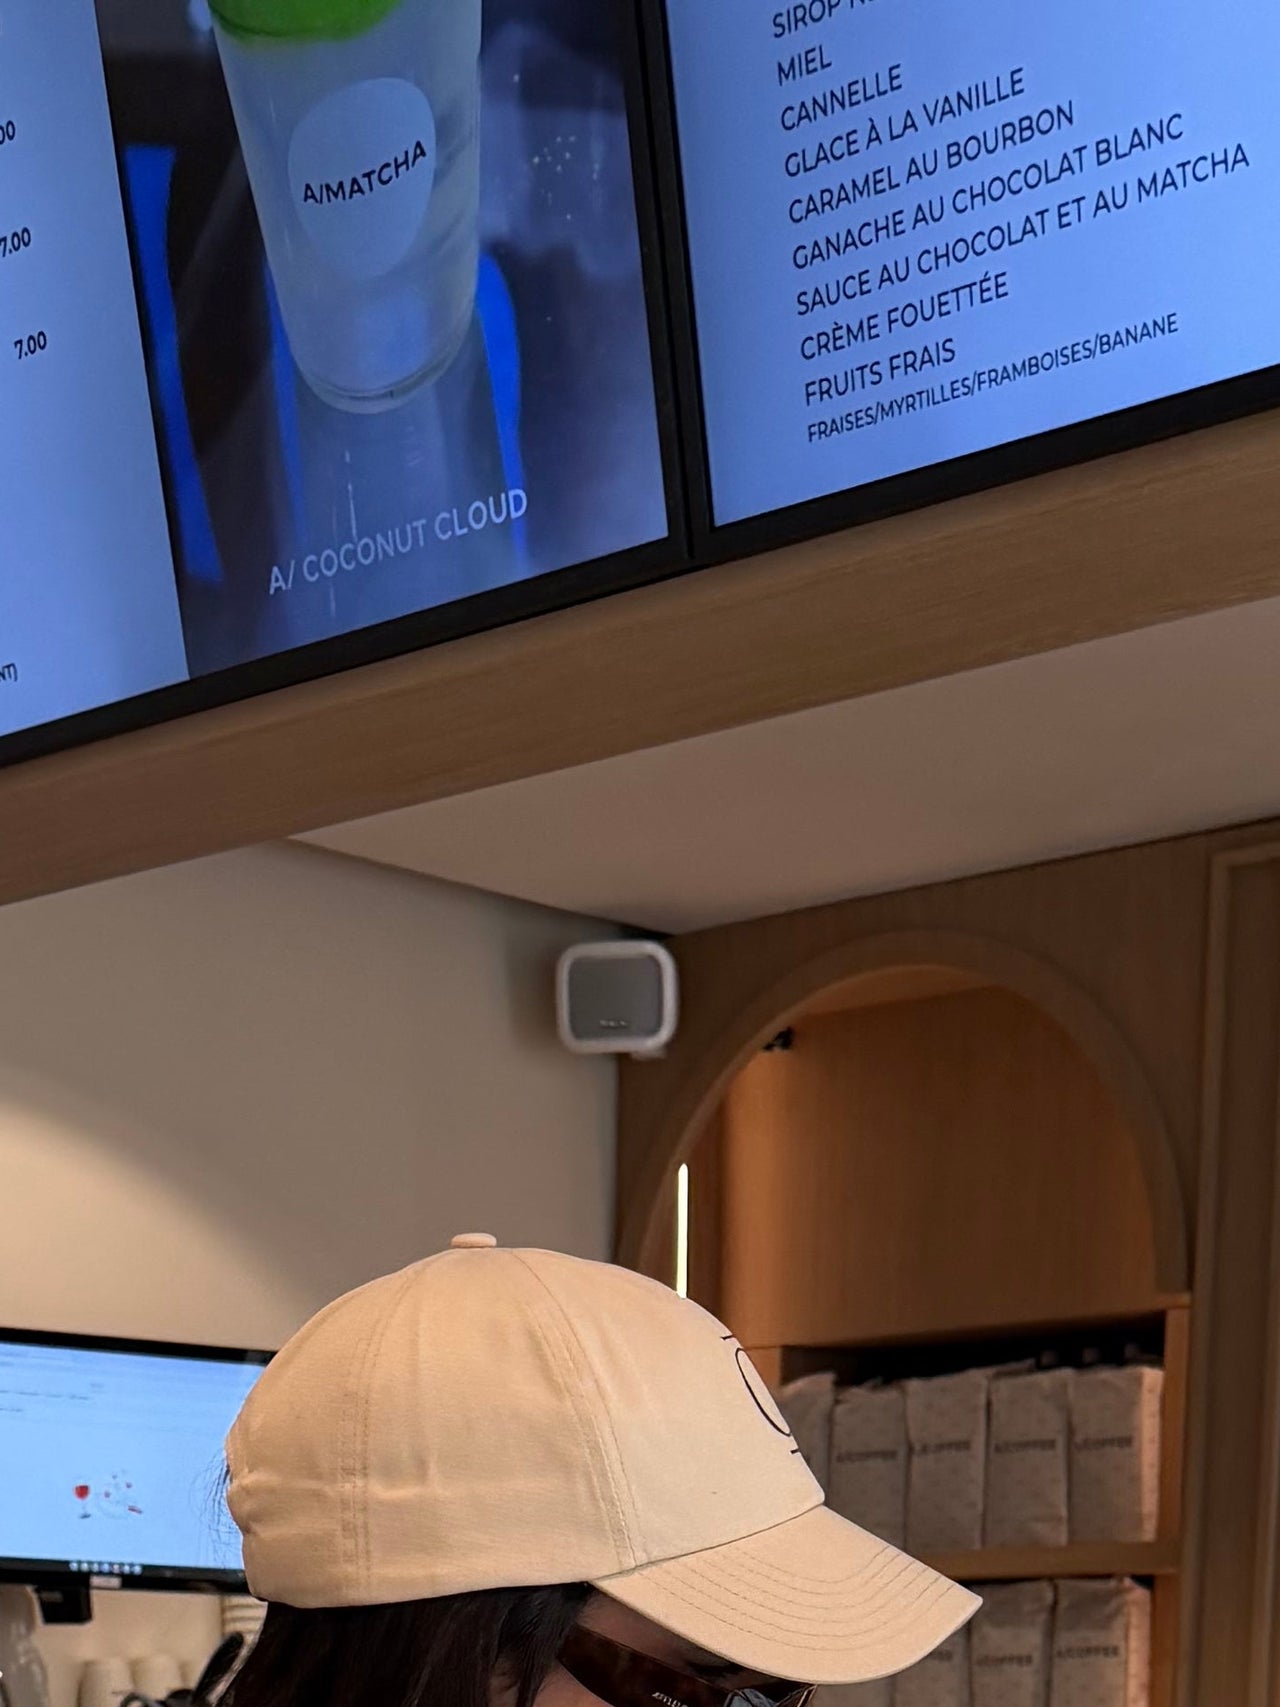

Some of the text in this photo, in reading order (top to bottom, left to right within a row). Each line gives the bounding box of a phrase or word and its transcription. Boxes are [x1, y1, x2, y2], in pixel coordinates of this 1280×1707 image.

[772, 0, 840, 38] SIROP
[777, 45, 832, 86] MIEL
[780, 62, 902, 131] CANNELLE
[784, 66, 1024, 177] GLACE À LA VANILLE
[788, 99, 1073, 223] CARAMEL AU BOURBON
[303, 140, 427, 205] A/MATCHA
[792, 112, 1183, 269] GANACHE AU CHOCOLAT BLANC
[796, 142, 1250, 316] SAUCE AU CHOCOLAT ET AU MATCHA
[13, 329, 47, 360] 7.00
[800, 270, 1009, 360] CRÈME FOUETTÉE
[804, 337, 955, 406] FRUITS FRAIS
[807, 311, 1178, 442] FRAISES/MYRTILLES/FRAMBOISES/BANANE
[269, 488, 528, 595] A/ COCONUT CLOUD
